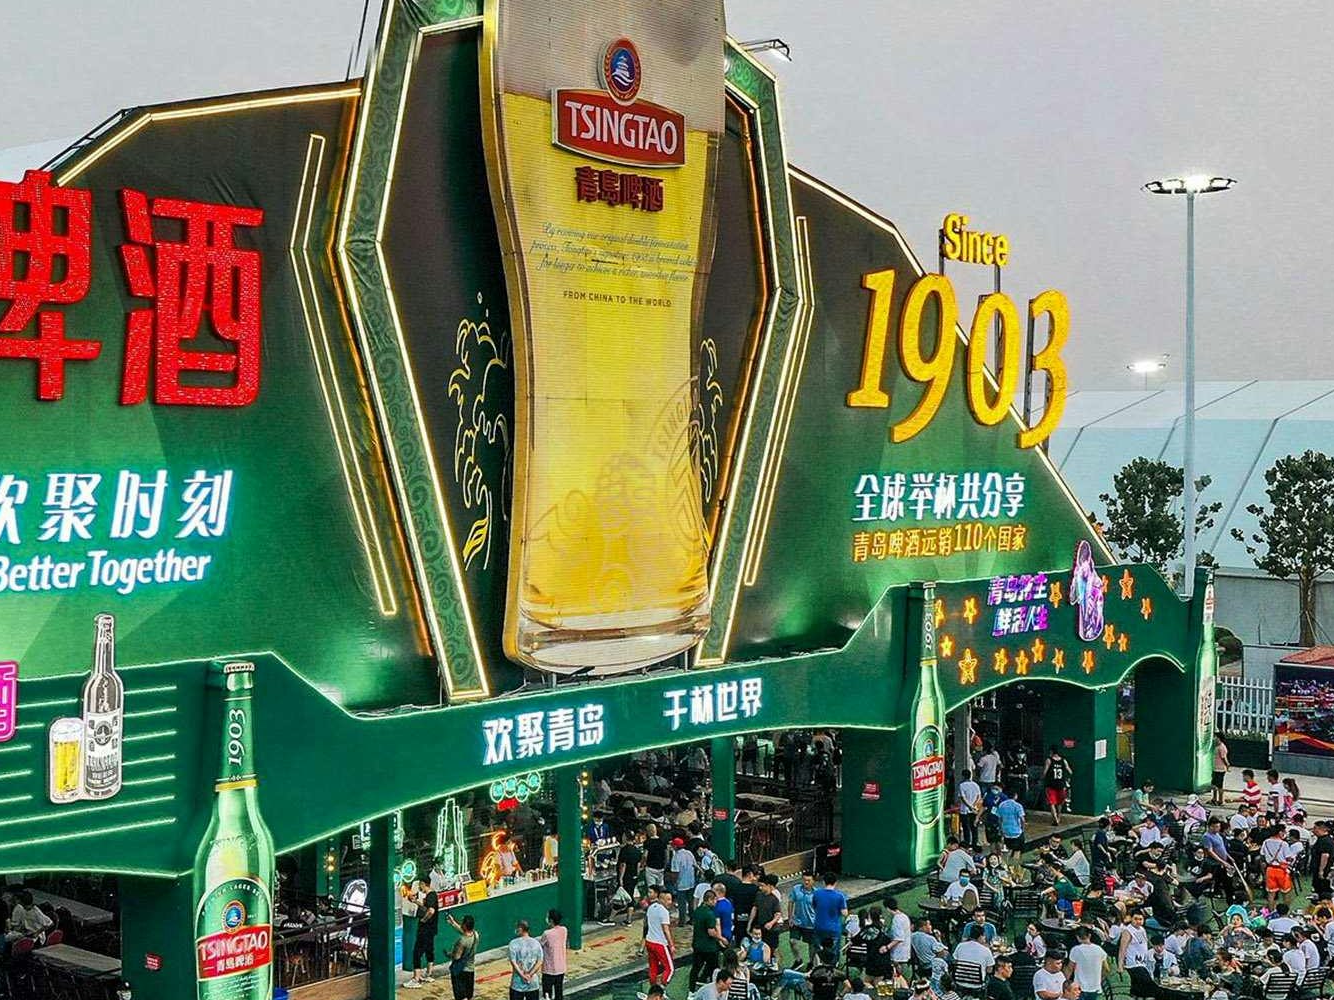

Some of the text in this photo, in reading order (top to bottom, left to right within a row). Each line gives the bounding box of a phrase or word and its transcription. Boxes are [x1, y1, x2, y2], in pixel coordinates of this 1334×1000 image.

[565, 100, 678, 155] TSINGTAO
[942, 212, 1010, 267] Since
[563, 290, 673, 308] FROM CHINA TO THE WORLD
[847, 267, 1071, 449] 1903
[852, 473, 1026, 522] 全球举杯共分享
[853, 523, 1027, 563] 青岛啤酒远销110个国家
[87, 548, 212, 595] Together
[924, 612, 934, 650] 1903
[662, 677, 764, 732] 干杯世界
[227, 708, 246, 766] 1903
[482, 703, 604, 766] 欢聚青岛
[1053, 767, 1063, 780] 13
[199, 930, 268, 961] TSINGTAO
